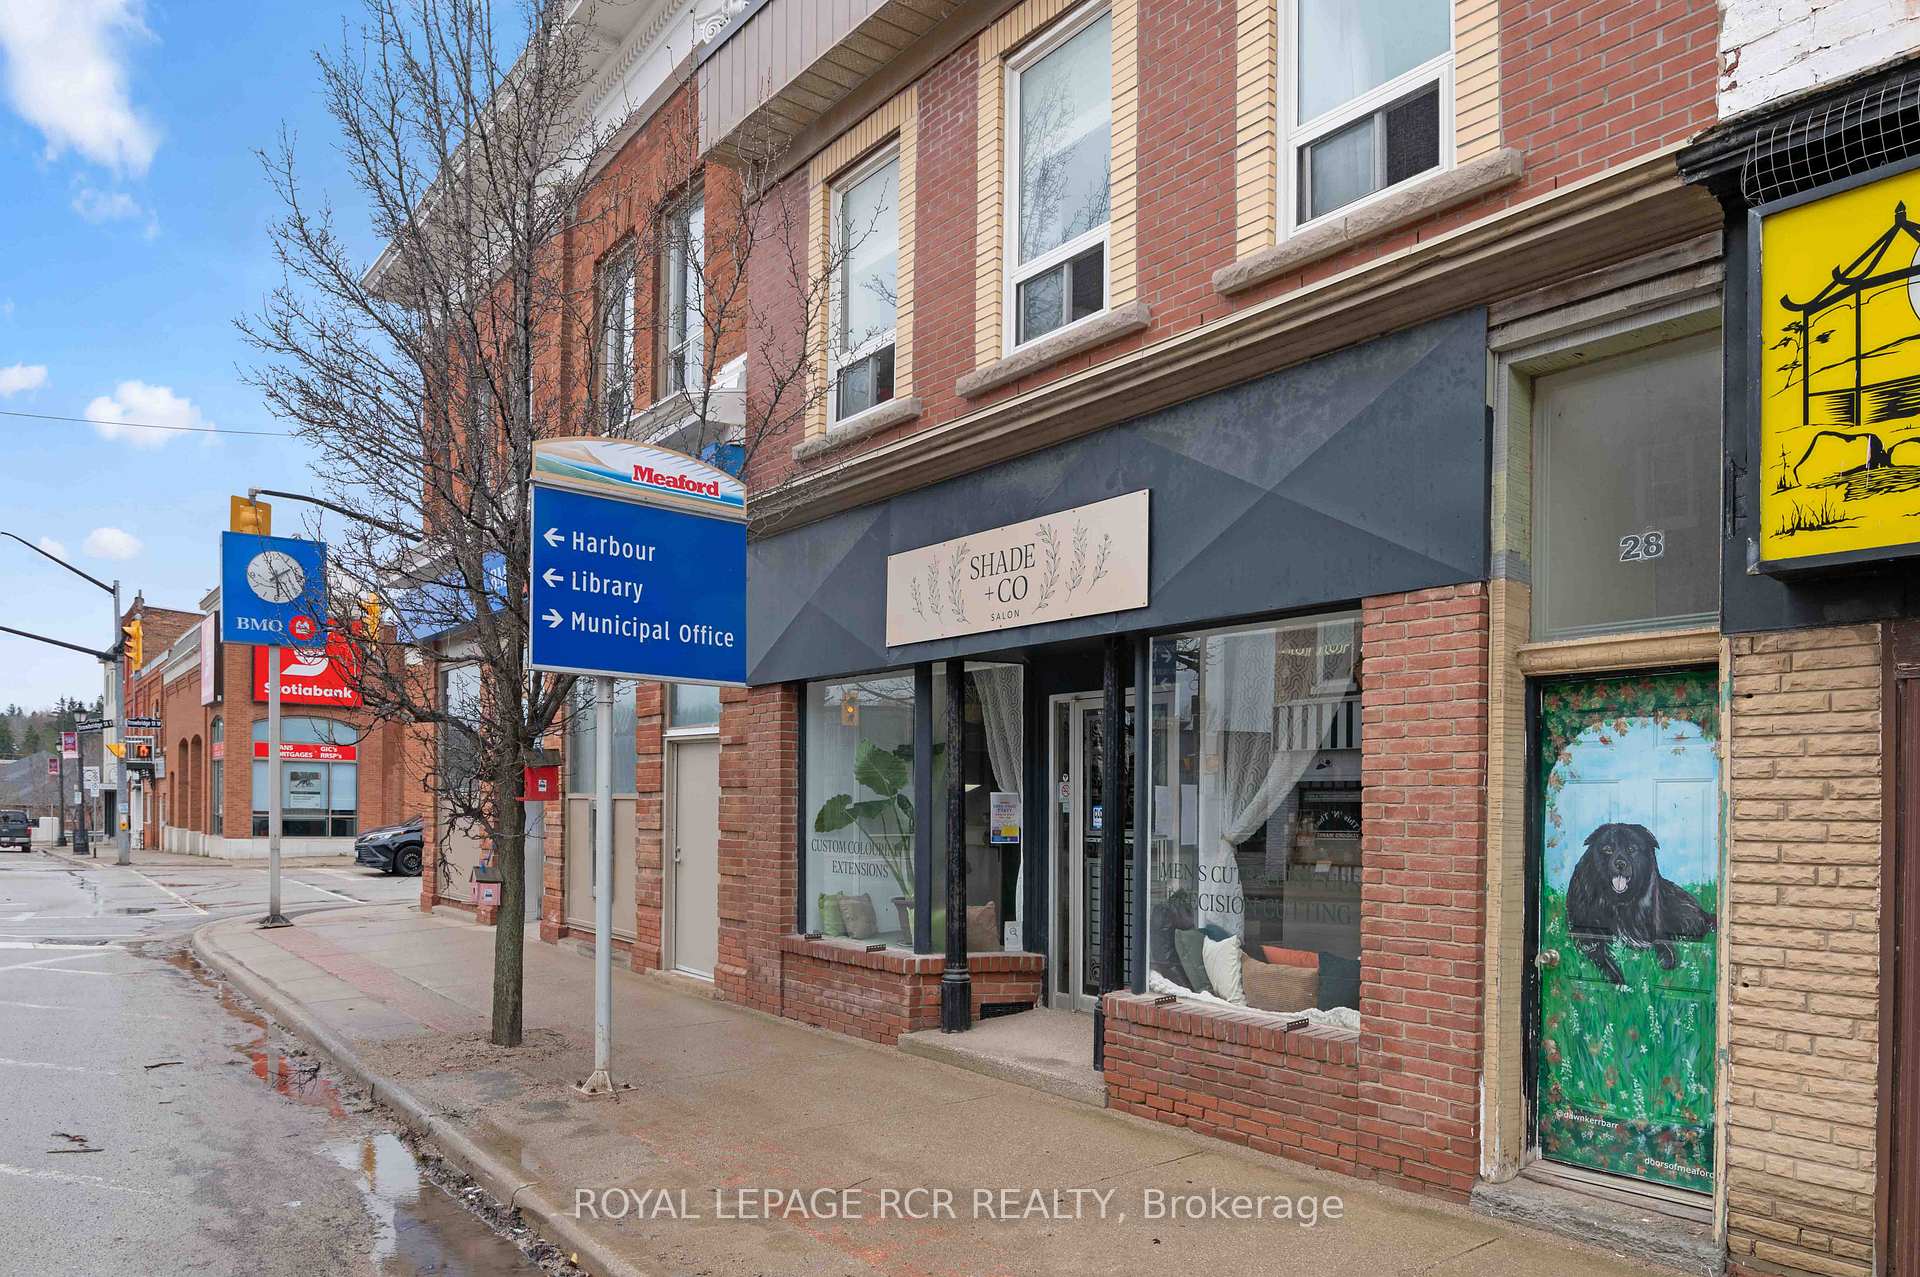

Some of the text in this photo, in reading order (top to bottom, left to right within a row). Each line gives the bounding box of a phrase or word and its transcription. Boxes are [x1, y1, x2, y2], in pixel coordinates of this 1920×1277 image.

[633, 464, 720, 497] Meaford
[572, 531, 656, 562] Harbour
[1620, 531, 1664, 562] 28
[970, 543, 1036, 580] SHADE
[572, 571, 643, 603] Library
[236, 616, 283, 633] BMO
[990, 609, 1020, 622] SALON
[571, 611, 734, 648] Municipal Office
[264, 681, 353, 699] Sotiabank
[811, 838, 904, 858] CUSTOM COLOURIN
[832, 860, 889, 879] EXTENSIONS
[1160, 863, 1207, 882] MENS
